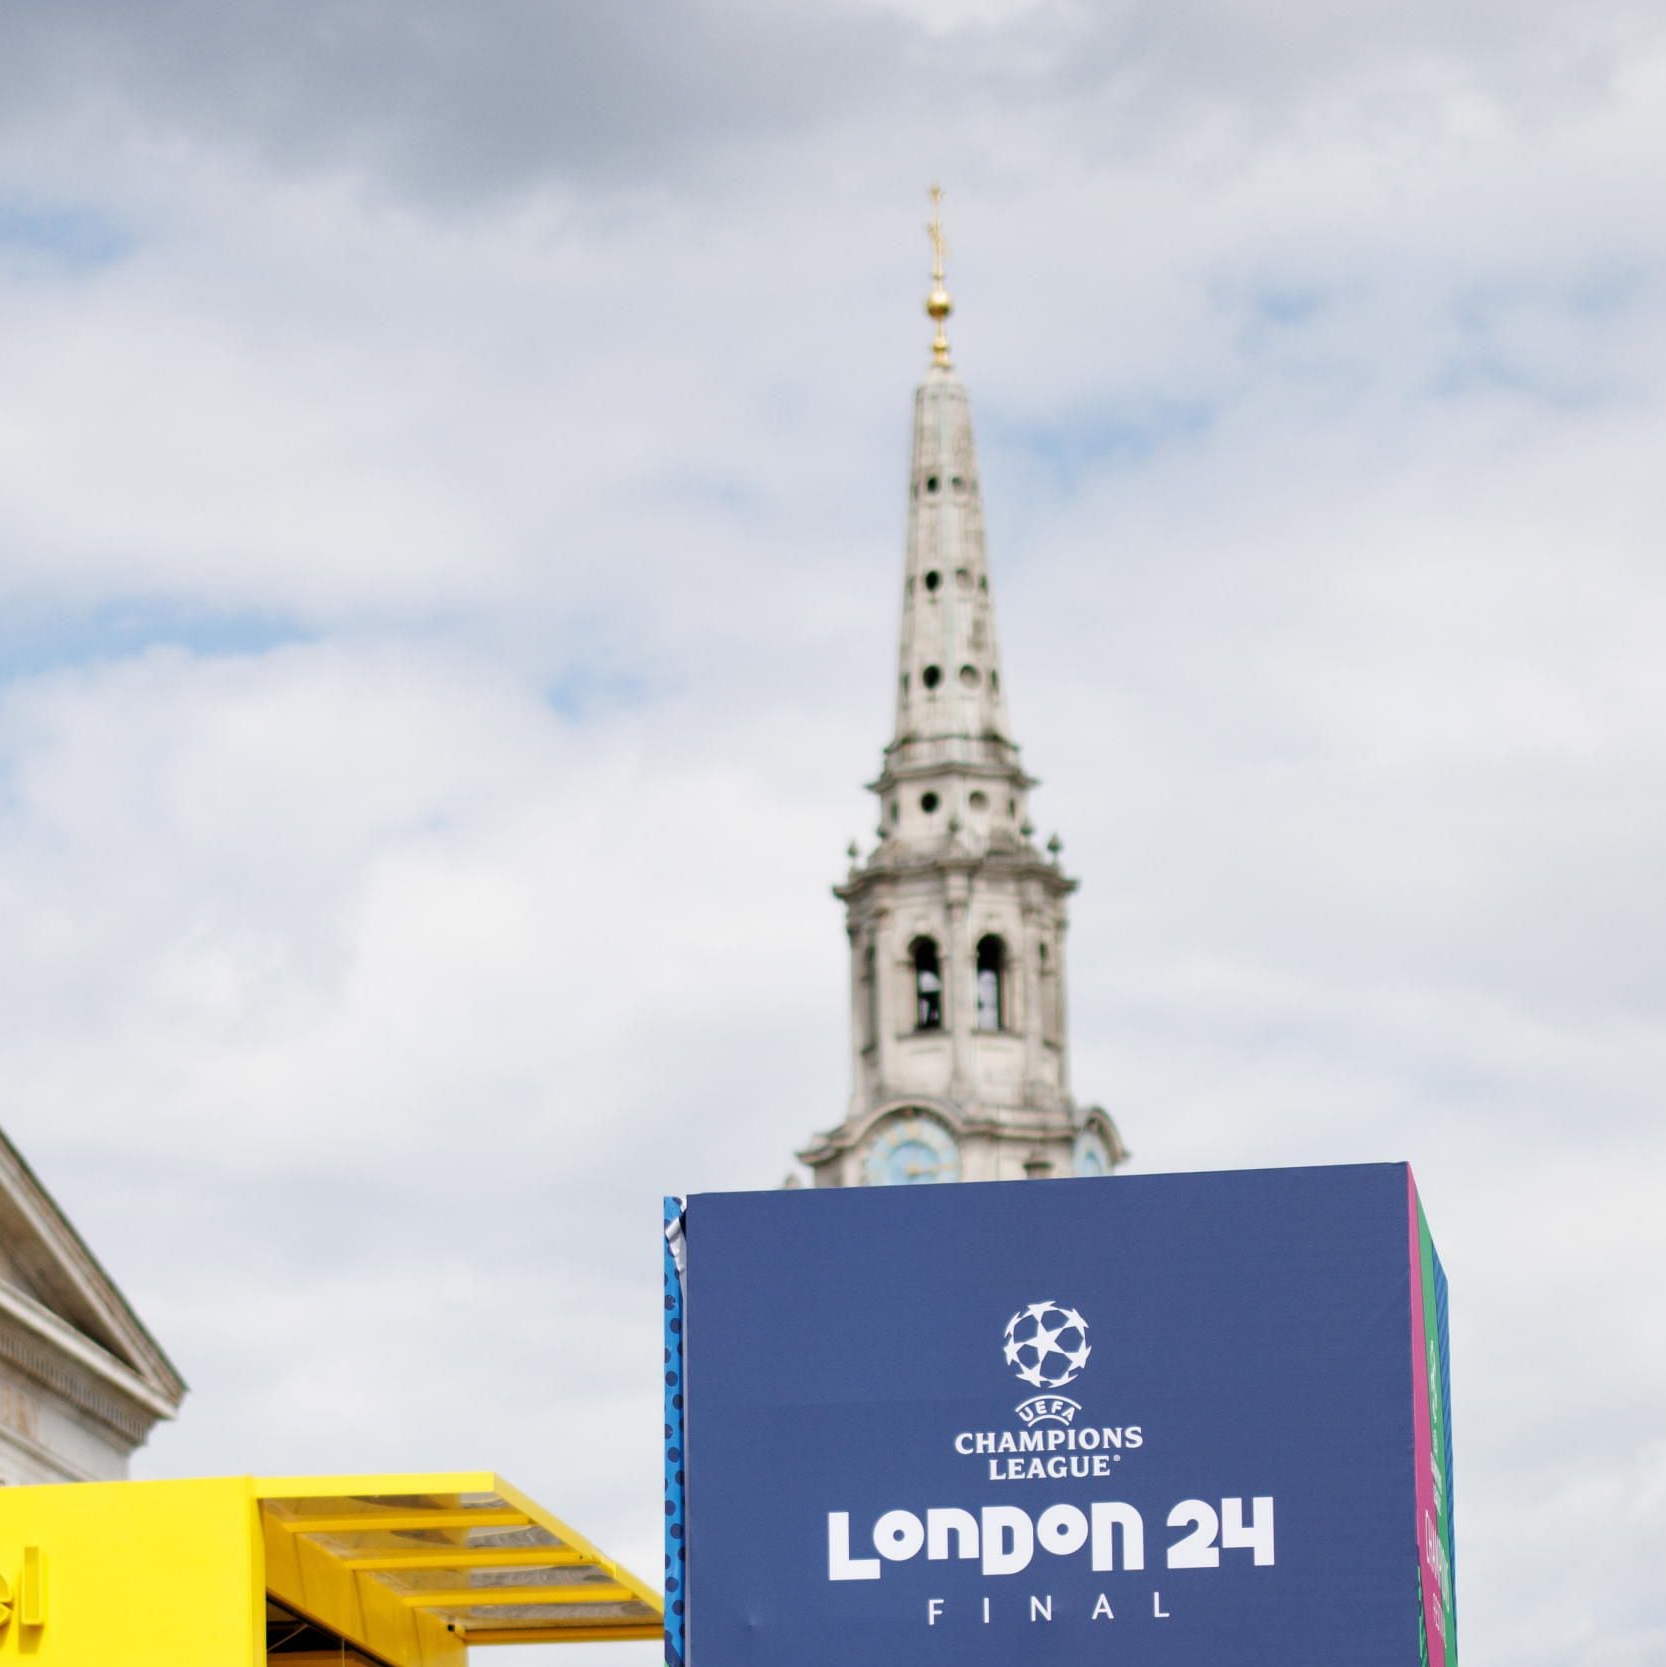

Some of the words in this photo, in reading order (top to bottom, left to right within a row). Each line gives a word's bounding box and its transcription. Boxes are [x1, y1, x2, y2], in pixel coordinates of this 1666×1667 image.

[1017, 1400, 1076, 1422] UEFA
[954, 1426, 1144, 1455] CHAMPIONS
[988, 1455, 1112, 1481] LEAGUE
[1166, 1496, 1275, 1569] 24
[928, 1591, 1171, 1626] FINAL
